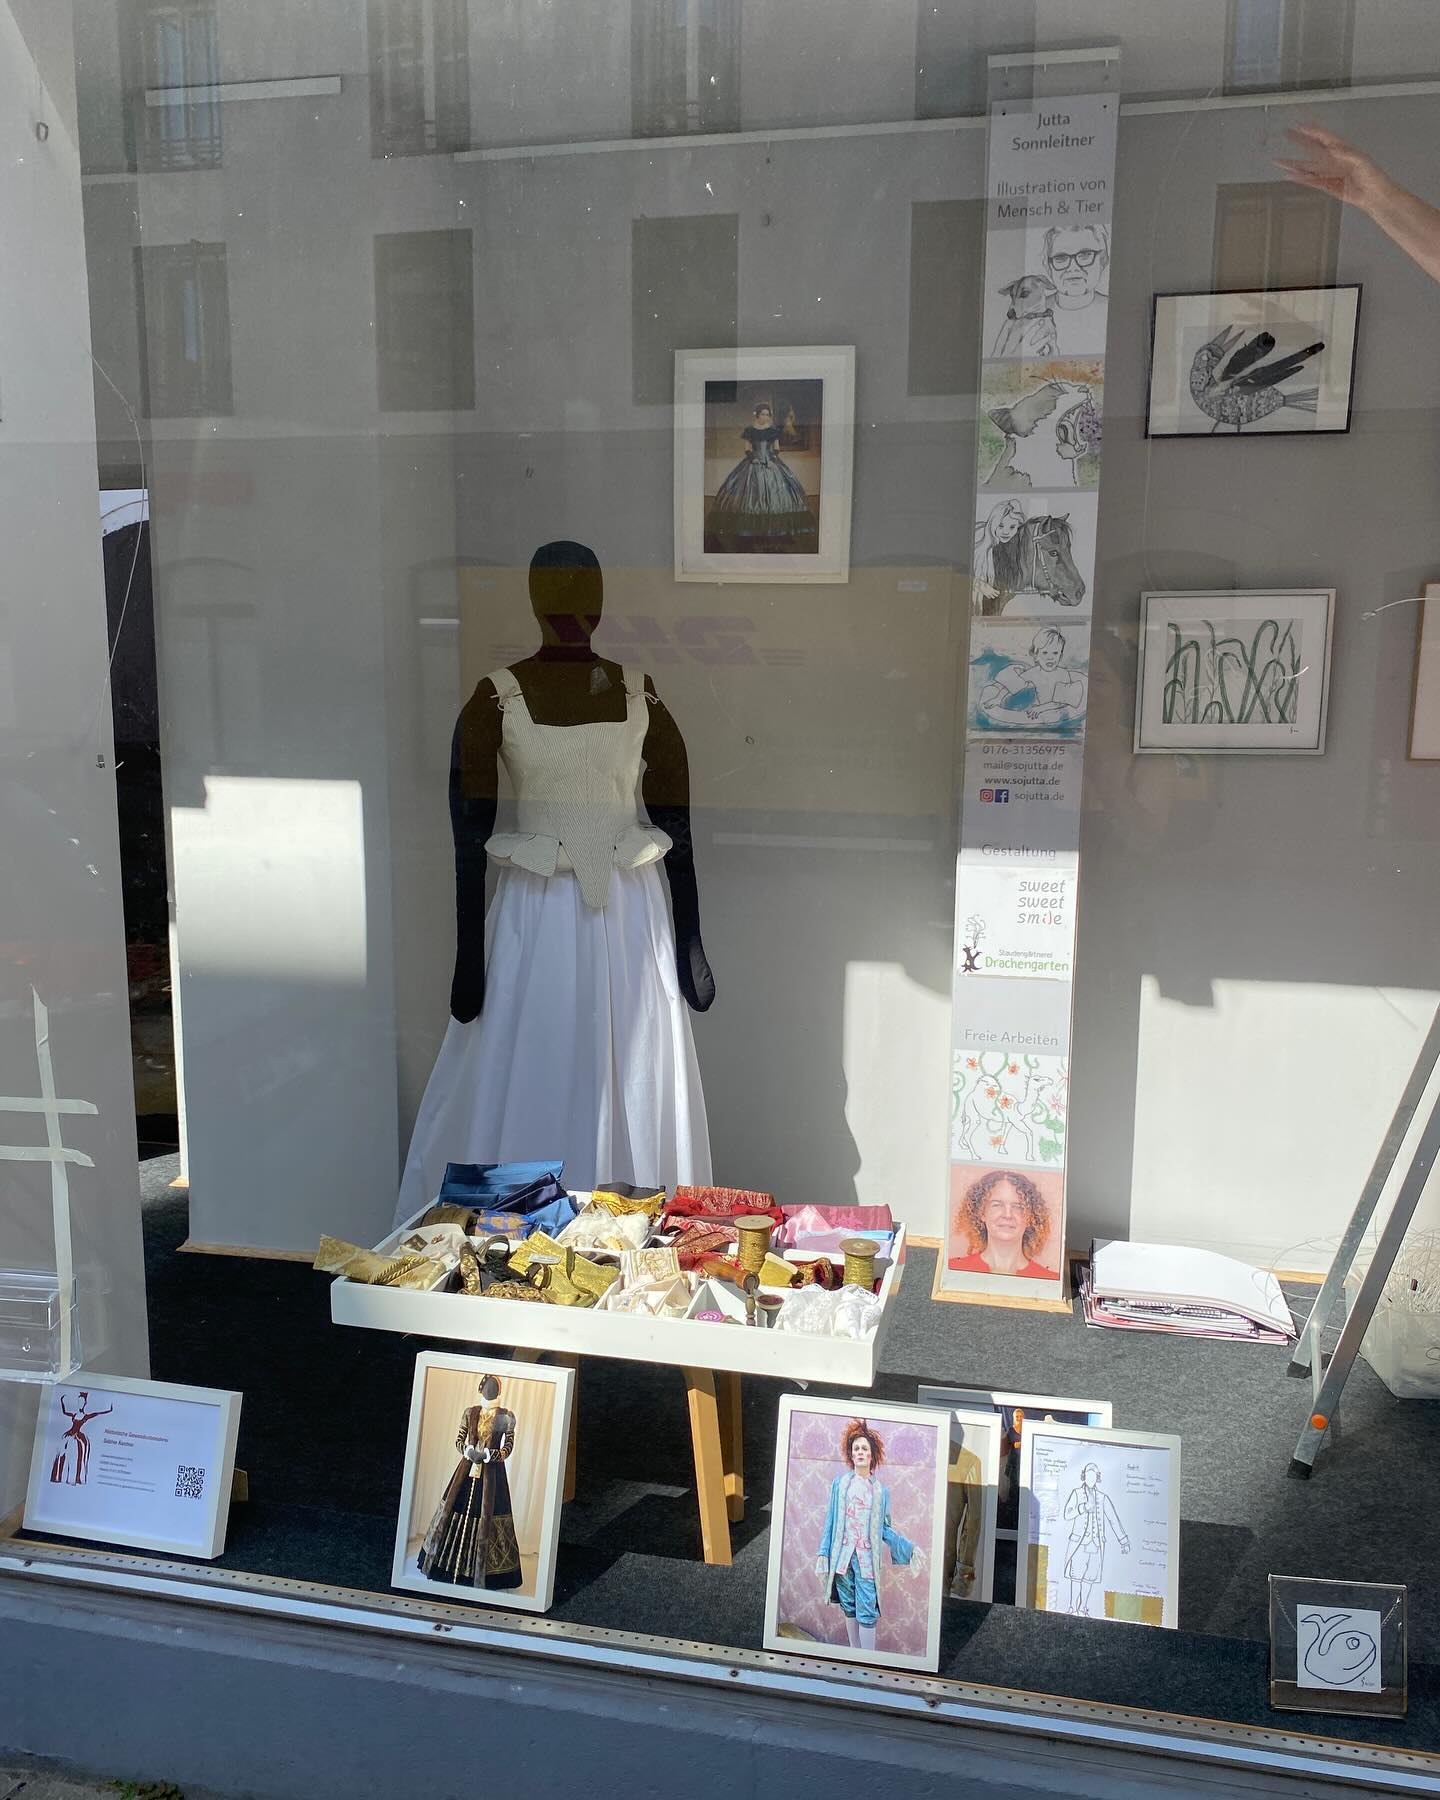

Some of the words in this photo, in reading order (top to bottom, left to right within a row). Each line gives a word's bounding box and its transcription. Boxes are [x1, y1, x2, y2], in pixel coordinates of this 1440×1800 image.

[1036, 112, 1071, 130] Jutta
[1011, 134, 1096, 151] Sonnleitner
[997, 180, 1075, 196] Illustration
[1080, 179, 1106, 192] von
[997, 201, 1052, 218] Mensch
[1057, 201, 1071, 215] &
[1075, 199, 1104, 213] Tier
[982, 745, 1065, 756] 0176-31356975
[983, 761, 1064, 772] mail@sojutta.de
[984, 776, 1061, 786] www.sojutta.de
[1014, 791, 1065, 801] sojutta.de
[981, 843, 1056, 859] Gestaltung
[1018, 879, 1066, 893] sweet
[1017, 895, 1064, 909] sweet
[985, 956, 1069, 973] Drachengarten
[964, 1028, 998, 1042] Freie
[1000, 1031, 1059, 1046] Arbeiten
